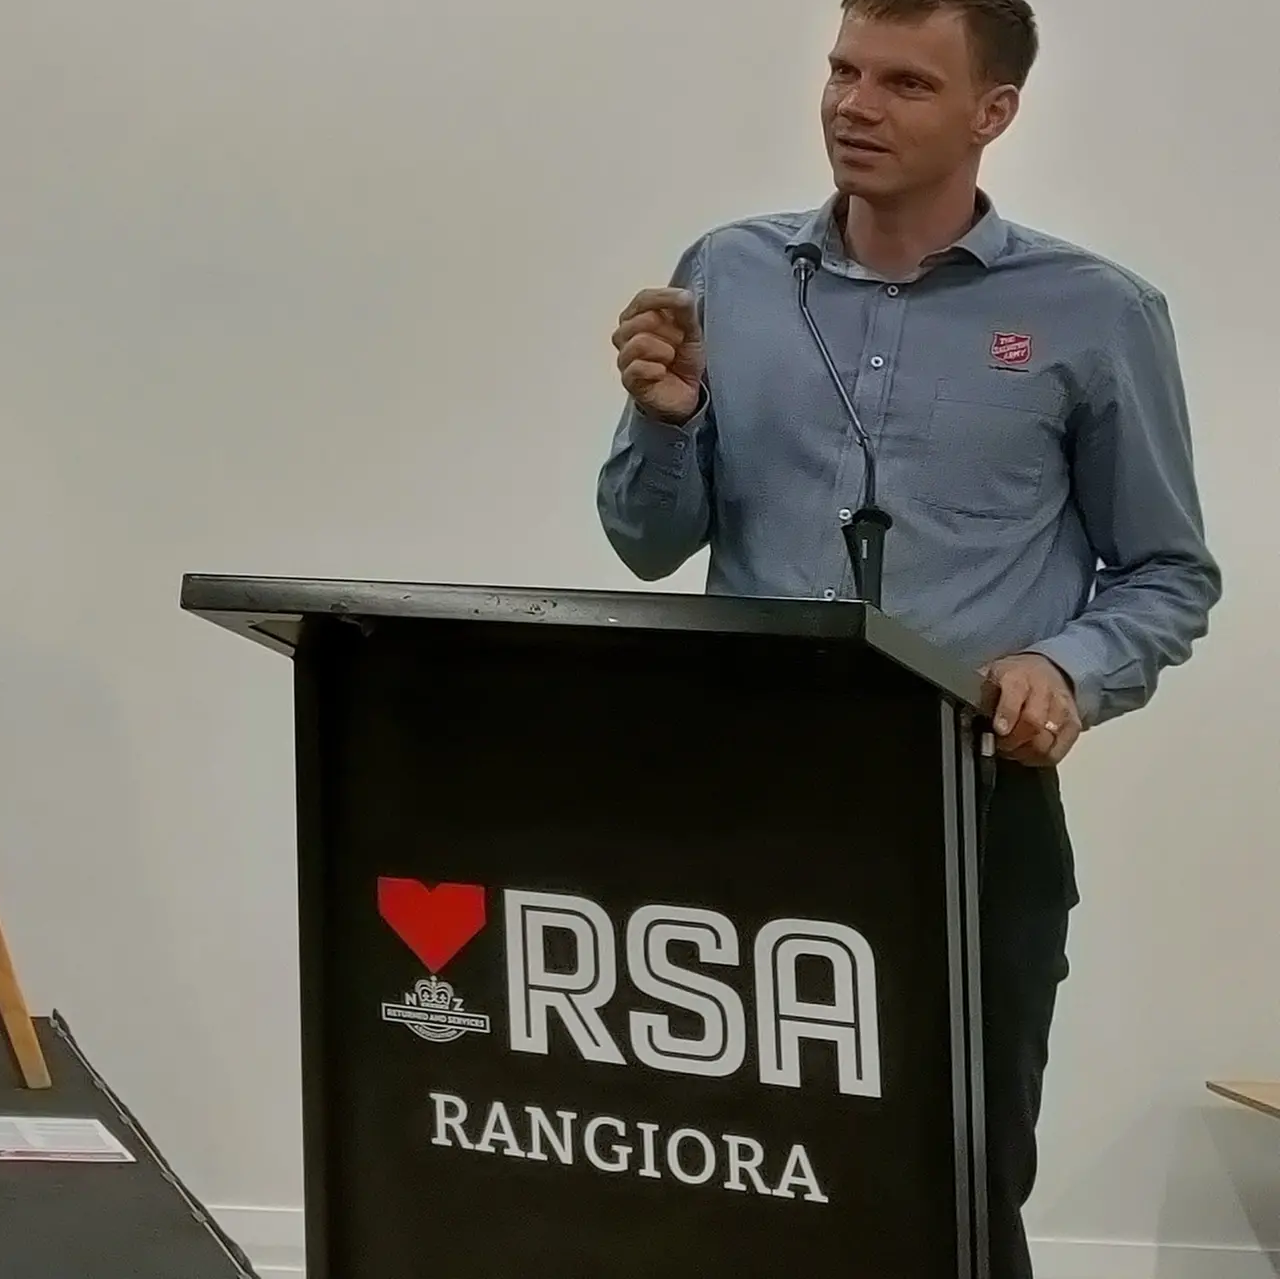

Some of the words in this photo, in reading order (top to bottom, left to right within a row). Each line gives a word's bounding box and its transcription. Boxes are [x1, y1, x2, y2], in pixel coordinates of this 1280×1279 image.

[404, 992, 417, 1006] N
[452, 998, 465, 1012] Z
[504, 889, 881, 1098] RSA
[429, 1092, 829, 1203] RANGIORA
